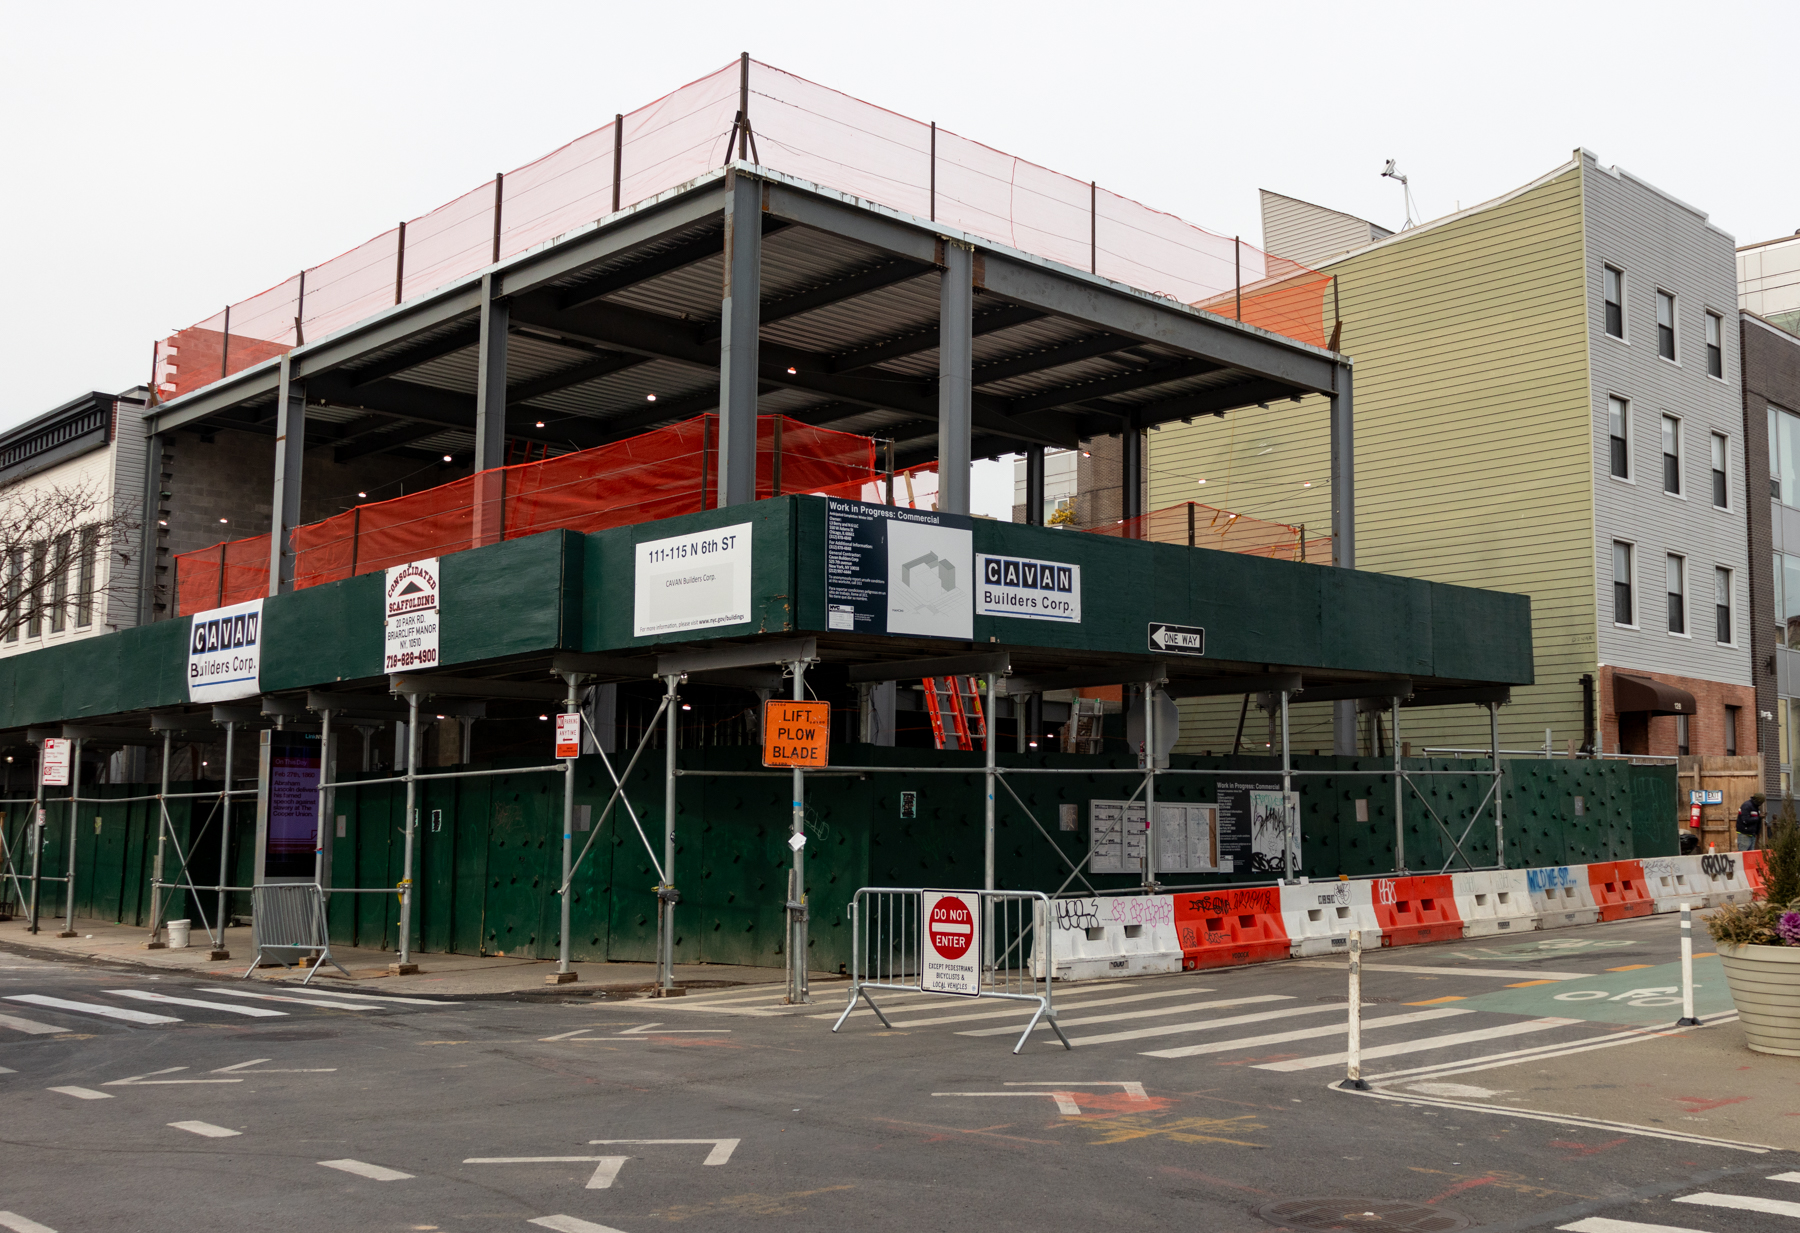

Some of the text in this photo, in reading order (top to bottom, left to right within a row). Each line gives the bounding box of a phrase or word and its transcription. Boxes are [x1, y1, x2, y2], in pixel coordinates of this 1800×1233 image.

[829, 501, 940, 524] Work in Progress: Commercial
[648, 535, 737, 564] 111-115 N 6th ST
[387, 566, 437, 598] CONSOLIDATED
[665, 573, 717, 588] CAVAN Builders Corp.
[987, 561, 1071, 591] CAVAN
[388, 594, 435, 613] SCAFFOLDING
[984, 590, 1074, 613] Builders Corp.
[395, 614, 426, 629] 20 PARK RD.
[656, 622, 678, 631] information,
[678, 620, 691, 629] please
[698, 614, 745, 625] www.nyc.gov/buildings
[194, 615, 258, 651] CAVAN
[387, 624, 437, 641] BRIARCLIFF MANOR
[1163, 632, 1198, 646] ONE WAY
[386, 648, 437, 669] 718-828-4900
[190, 656, 257, 678] Builders Corp.
[783, 709, 812, 722] LIFT
[559, 729, 577, 737] ANYTIME
[778, 727, 816, 741] PLOW
[772, 745, 818, 760] BLADE
[273, 810, 294, 818] Cooper
[934, 908, 968, 921] DO NOT
[936, 935, 966, 948] ENTER
[944, 963, 974, 973] PEDESTRIANS
[935, 972, 960, 981] BICYCLISTS
[932, 980, 968, 991] LOCAL VEHICLES
